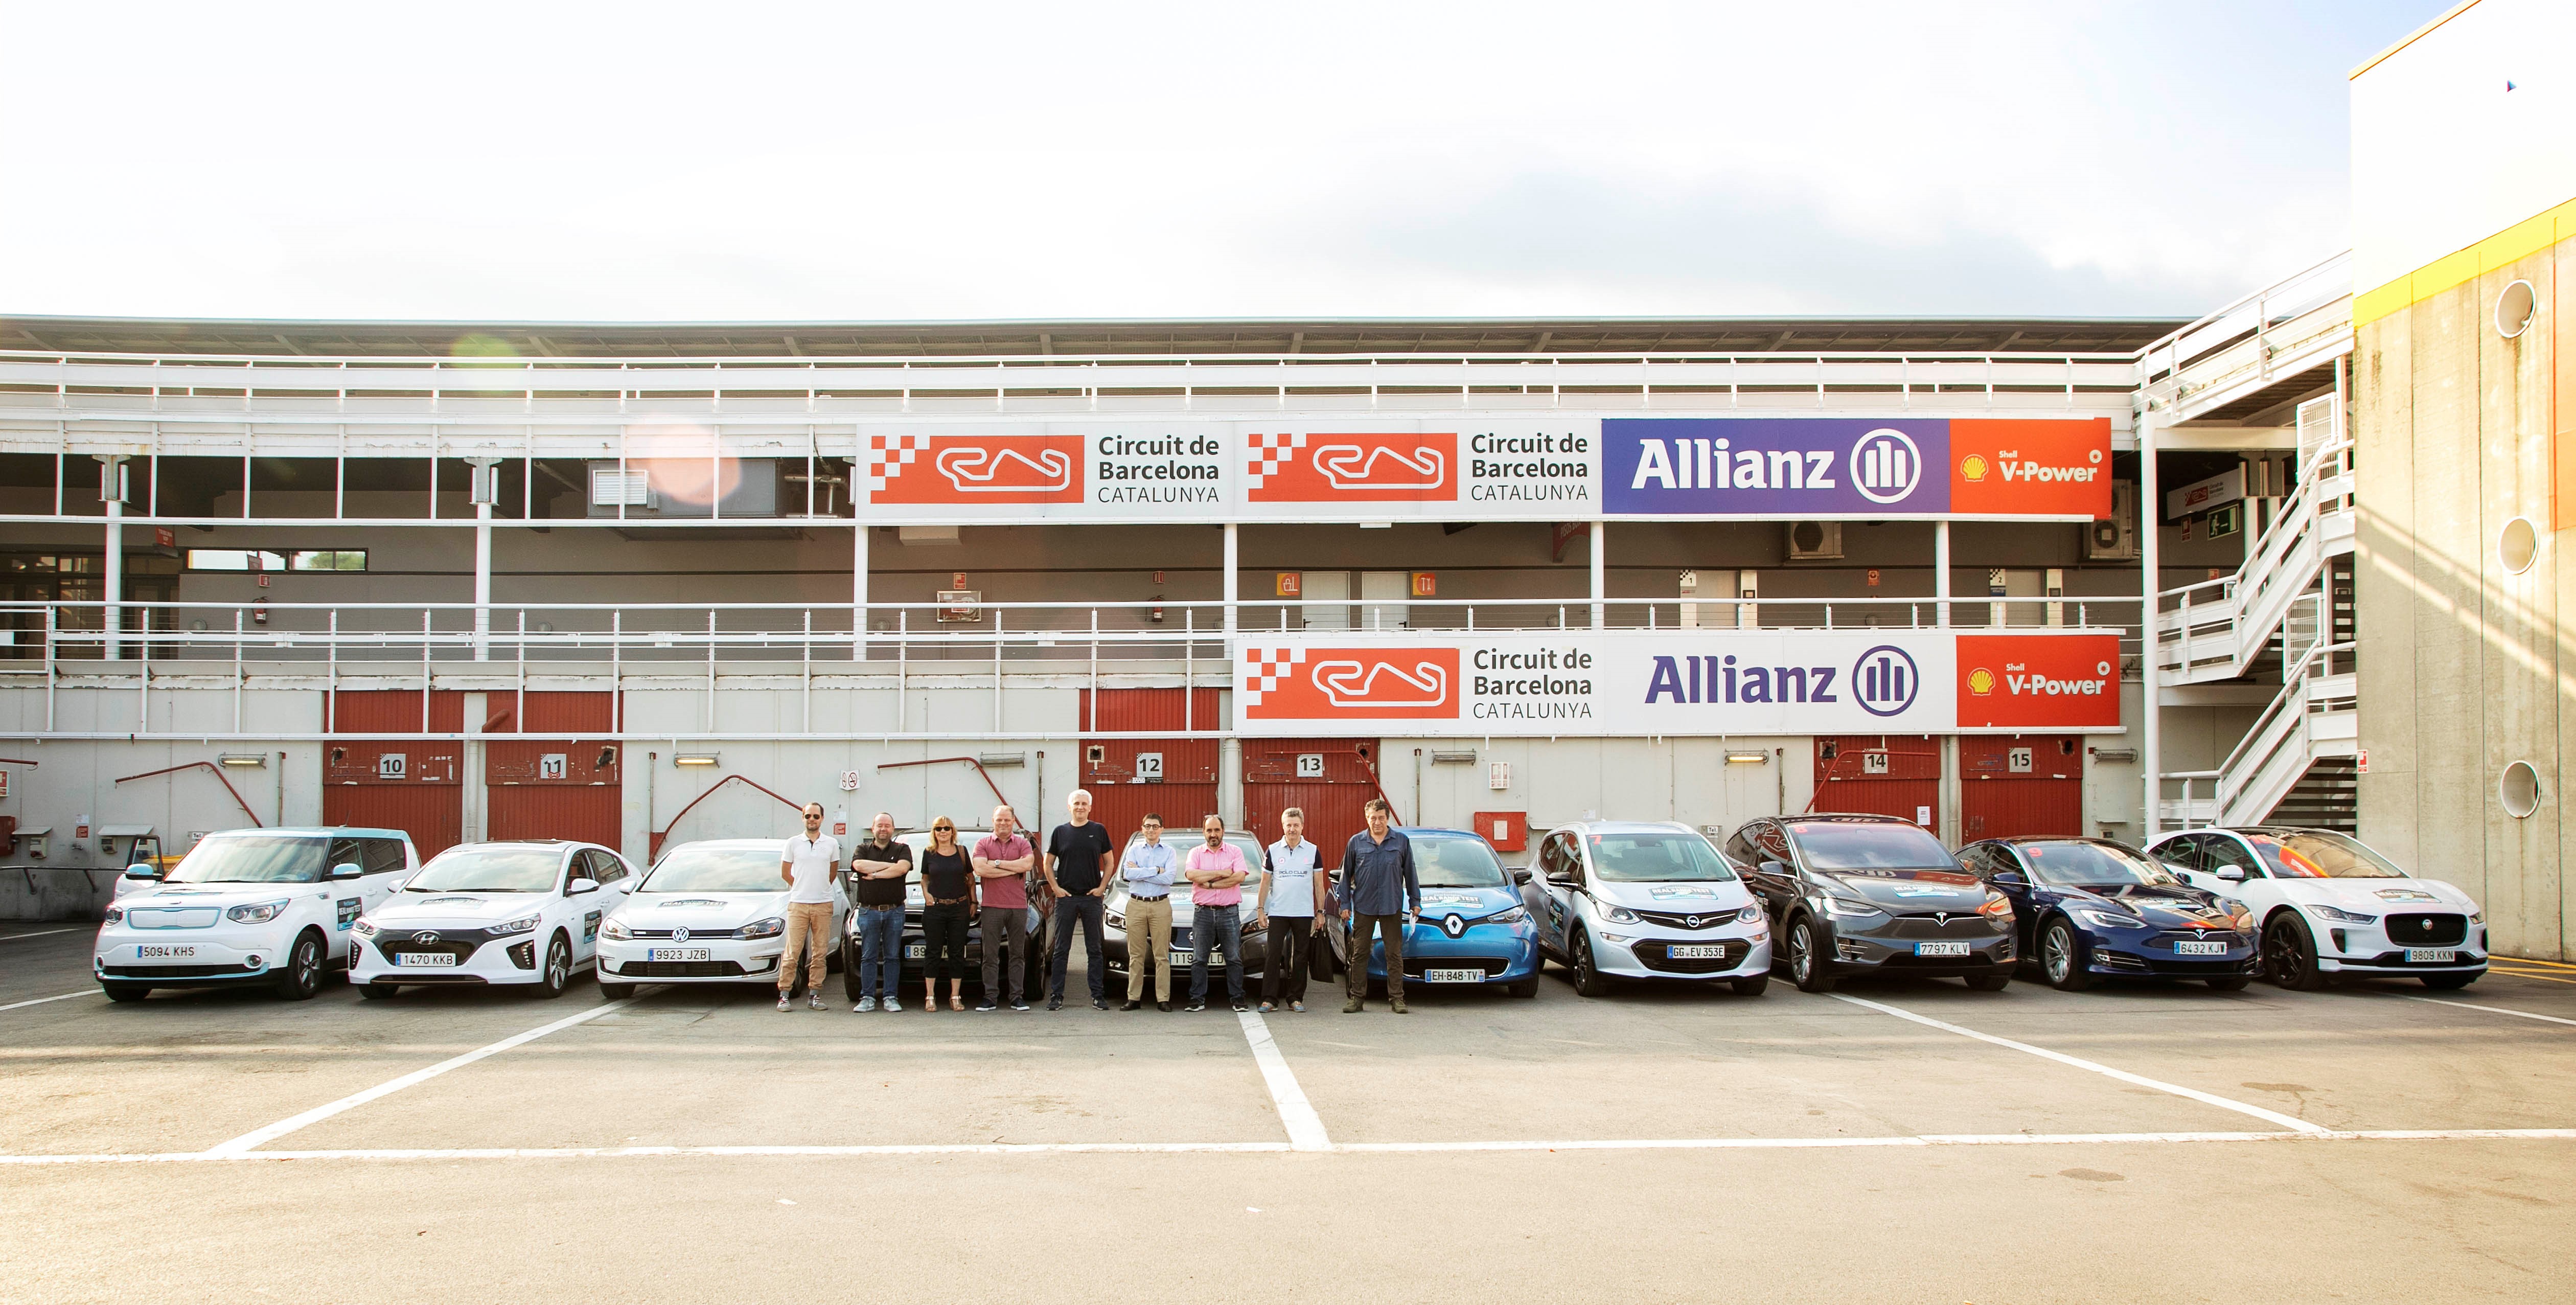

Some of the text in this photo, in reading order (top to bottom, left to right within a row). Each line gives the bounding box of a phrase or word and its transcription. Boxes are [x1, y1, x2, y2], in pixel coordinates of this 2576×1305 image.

[1099, 434, 1219, 455] Circuit de
[1471, 432, 1588, 453] Circuit de
[1099, 460, 1218, 479] Barcelona
[1473, 458, 1588, 477] Barcelona
[1631, 438, 1835, 489] Allianz
[1998, 461, 2098, 482] V-Power
[1098, 487, 1219, 502] CATALUNYA
[1471, 485, 1588, 500] CATALUNYA
[1474, 648, 1592, 670] Circuit de
[1475, 675, 1591, 695] Barcelona
[1645, 655, 1837, 703] Allianz
[2006, 675, 2105, 695] V-Power
[1474, 703, 1592, 718] CATALUNYA
[383, 759, 402, 772] 10
[544, 760, 561, 772] 11
[1139, 759, 1160, 772] 12
[1300, 758, 1320, 771] 13
[1868, 754, 1886, 767] 14
[2012, 754, 2030, 766] 15
[1589, 835, 1602, 845] 7
[2028, 848, 2043, 858] 9
[144, 947, 194, 956] 5094 KHS
[656, 950, 706, 959] 9923 JZB
[1674, 948, 1723, 956] GG EV 353E
[1922, 945, 1967, 954] 7797 KLV
[2181, 945, 2205, 953] 6432
[2412, 951, 2453, 960] 9809 KKN
[405, 955, 453, 965] 1470 KKB
[1175, 954, 1224, 964] 119 LD
[1433, 972, 1478, 980] EH-848-TV
